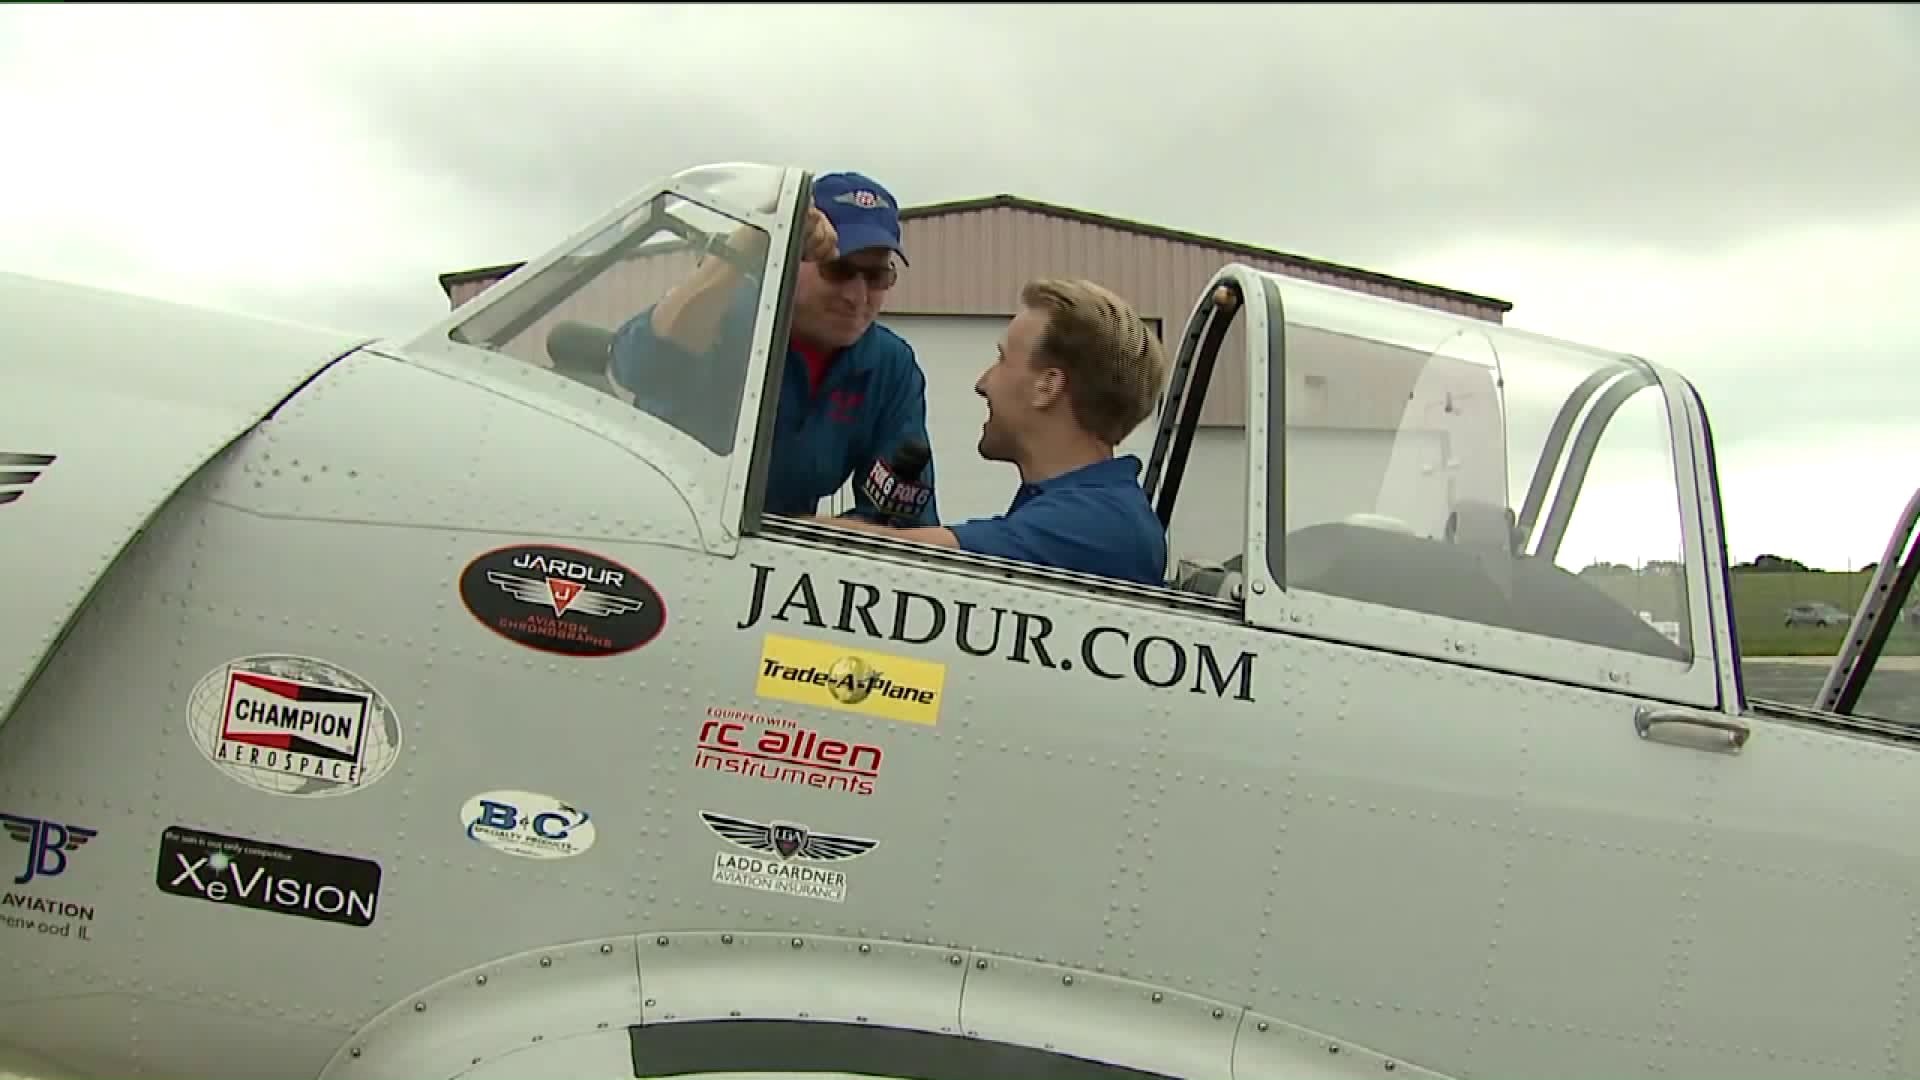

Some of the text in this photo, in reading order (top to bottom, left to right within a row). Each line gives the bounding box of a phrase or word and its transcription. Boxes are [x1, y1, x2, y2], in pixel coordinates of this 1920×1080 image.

[513, 554, 625, 587] JARDUR
[527, 615, 588, 634] AVIATION
[737, 563, 1258, 703] JARDUR.COM
[762, 658, 936, 705] Trade-A-Plane
[236, 698, 352, 739] CHAMPION
[706, 706, 797, 729] EQUIPPED WITH
[218, 742, 358, 781] AEROSPACE
[700, 721, 882, 771] rc allen
[715, 869, 772, 889] AVIATION
[717, 855, 844, 887] LADD GARDNER
[2, 891, 94, 921] AVIATION
